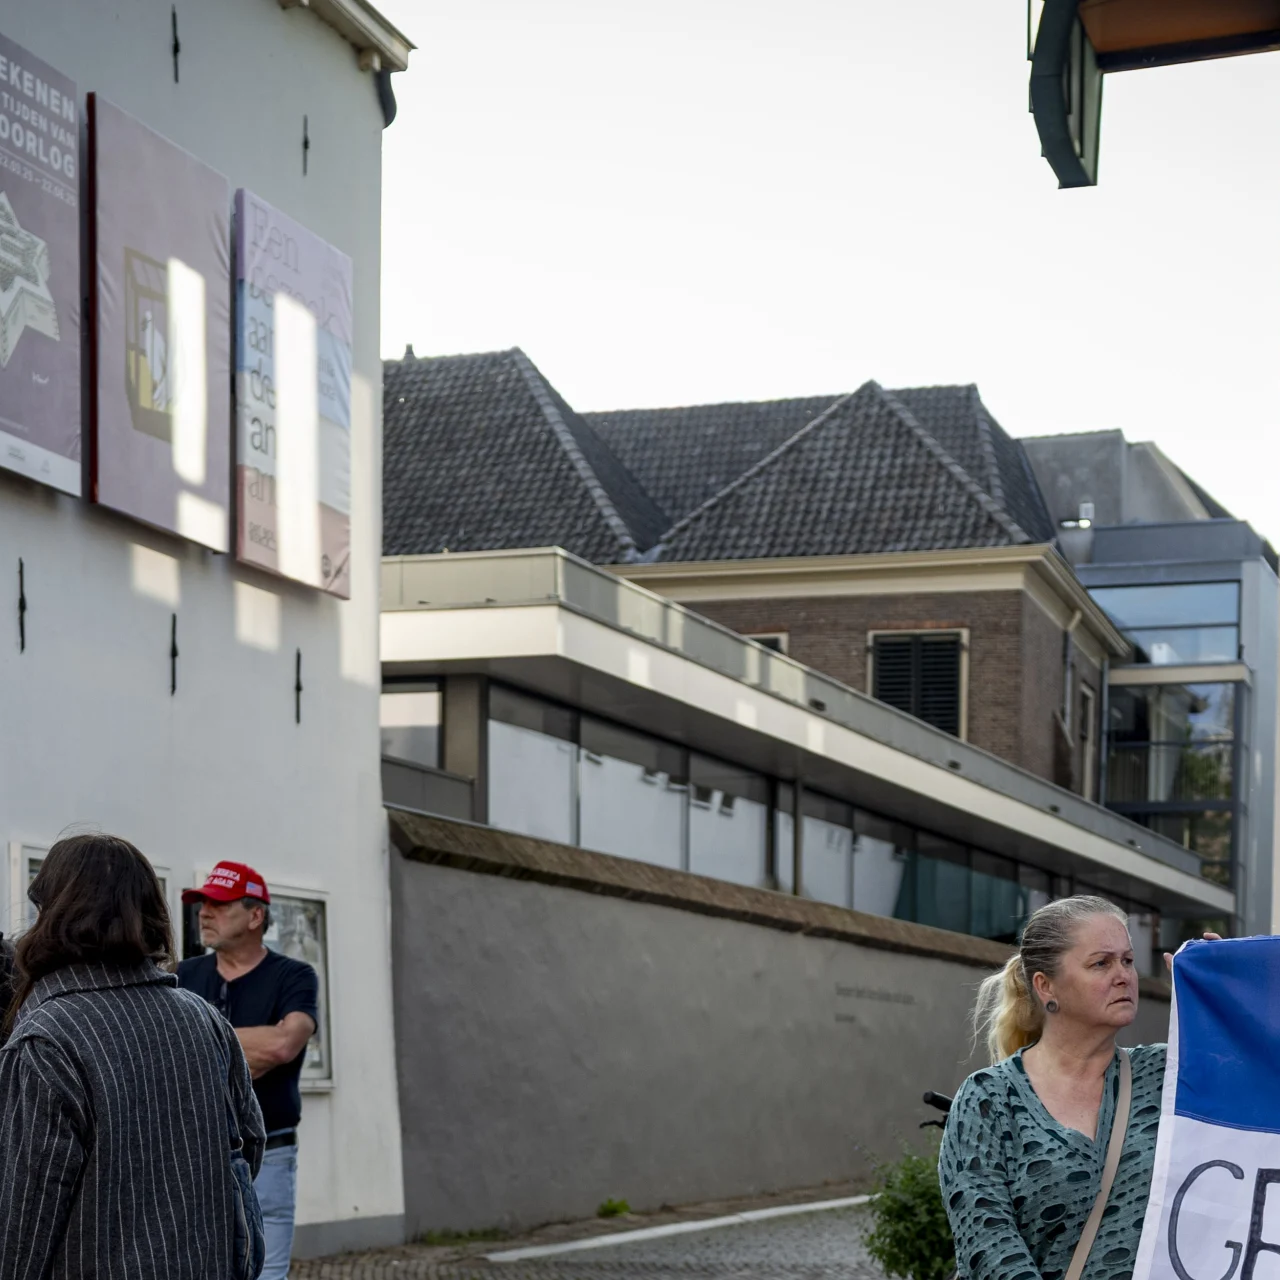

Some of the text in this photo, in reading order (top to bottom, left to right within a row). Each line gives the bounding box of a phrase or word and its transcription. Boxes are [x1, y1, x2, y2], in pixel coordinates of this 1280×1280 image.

[2, 91, 48, 132] TIJDEN
[50, 122, 76, 149] VAN
[250, 201, 301, 274] Een
